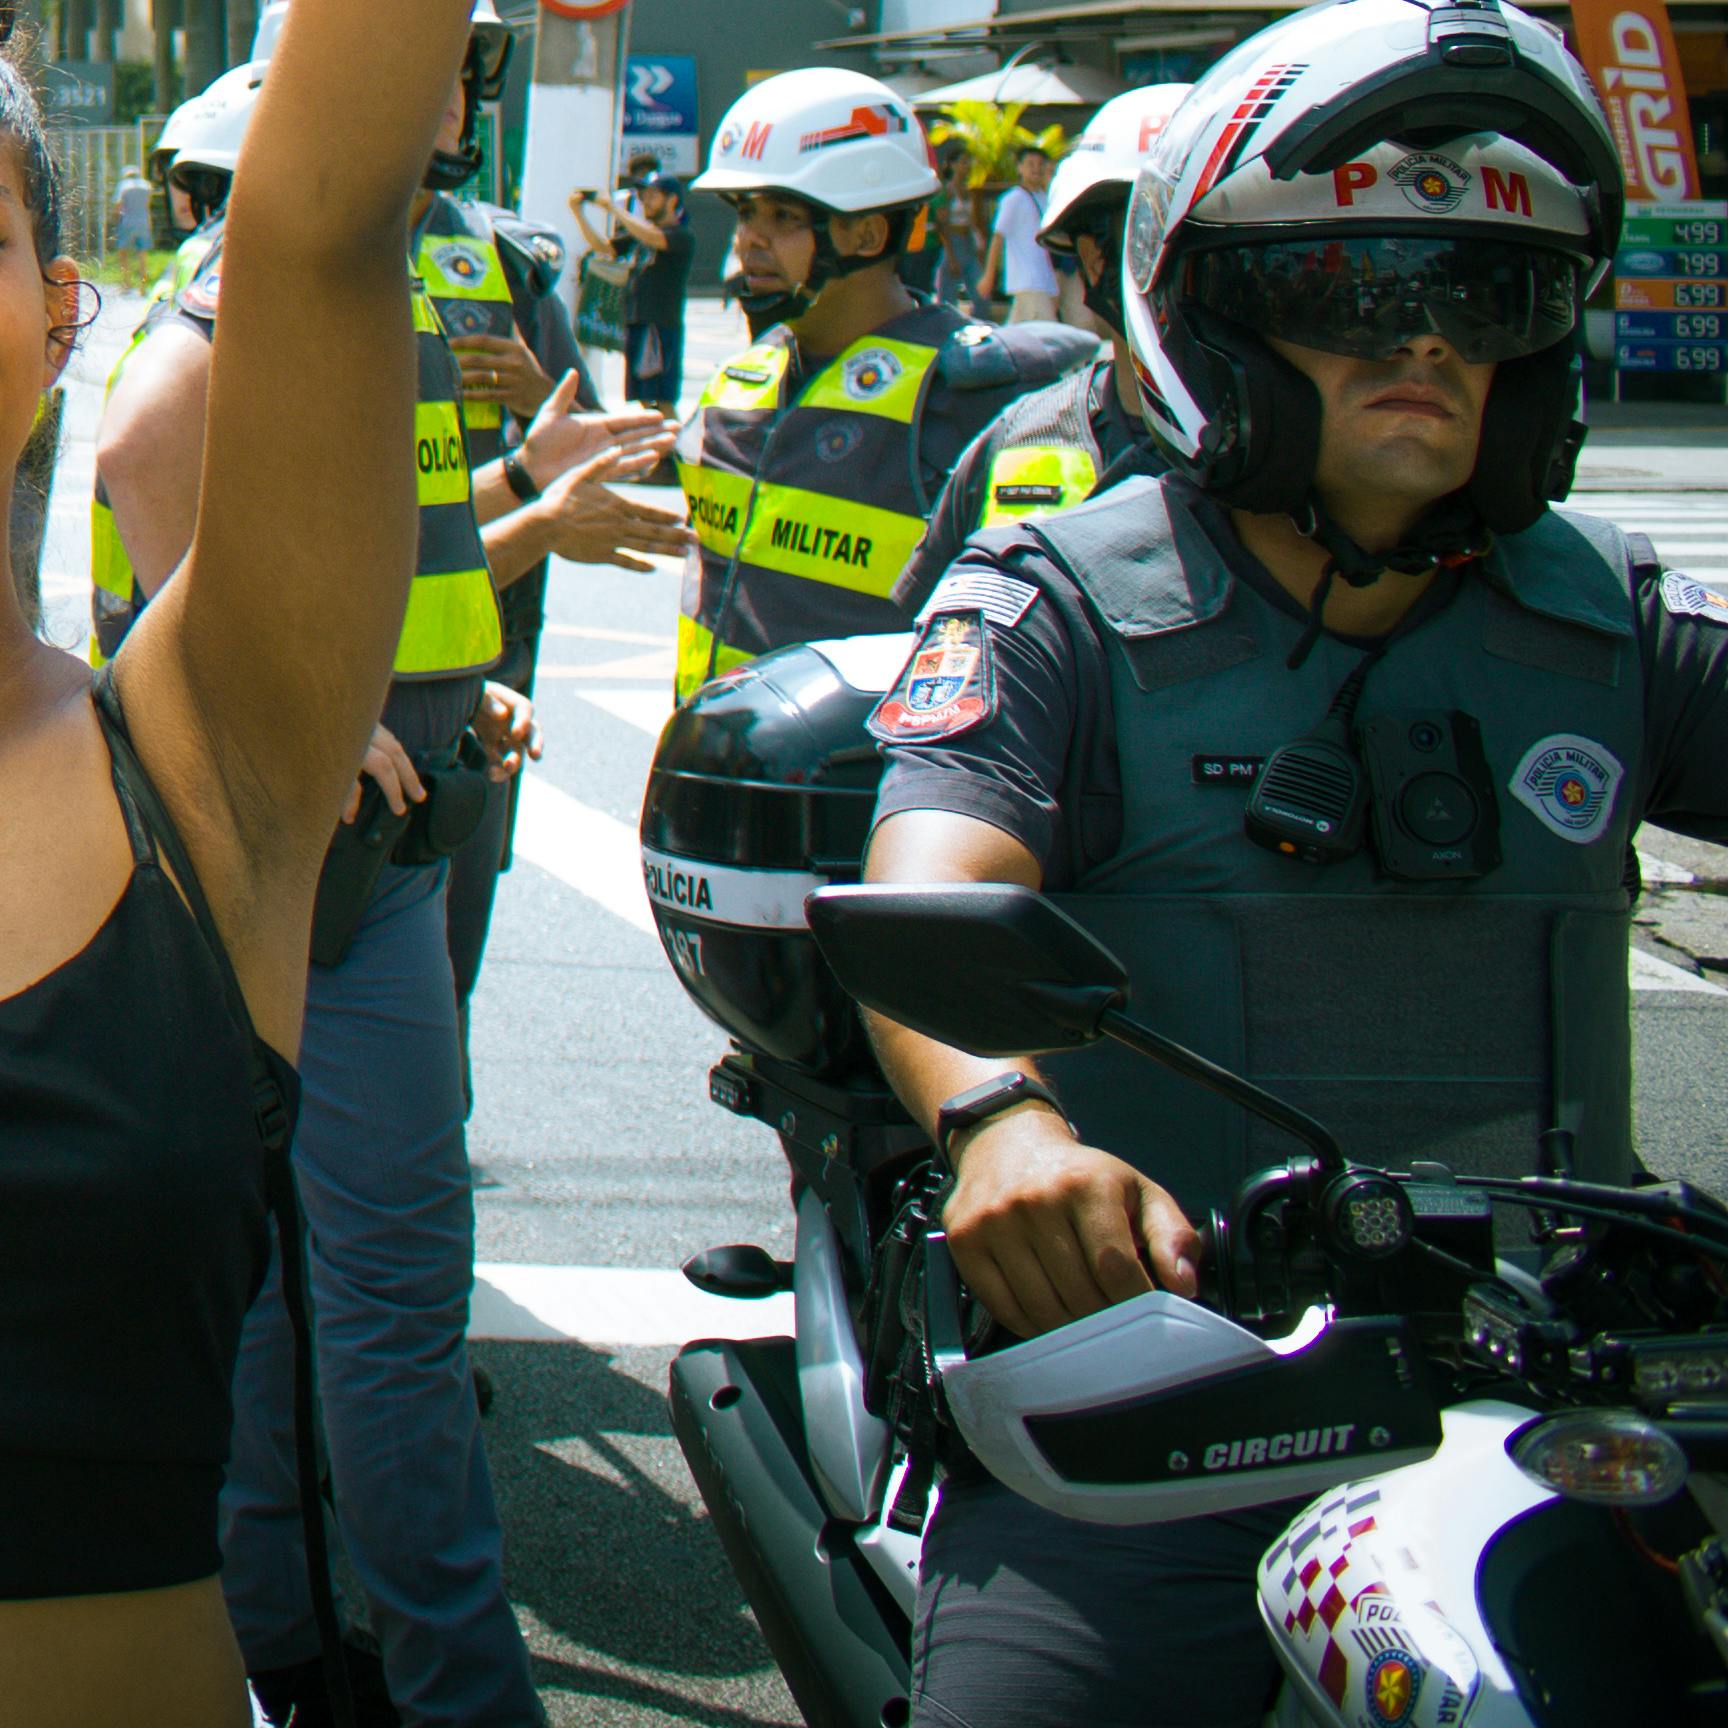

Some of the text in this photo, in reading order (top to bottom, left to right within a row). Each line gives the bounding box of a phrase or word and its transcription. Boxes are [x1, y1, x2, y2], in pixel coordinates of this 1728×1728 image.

[1333, 162, 1377, 208] P
[1480, 165, 1533, 218] M
[771, 517, 872, 569] MILITAR
[1203, 762, 1224, 775] SD
[1229, 762, 1253, 776] PM
[1202, 1424, 1356, 1472] CIRCUIT
